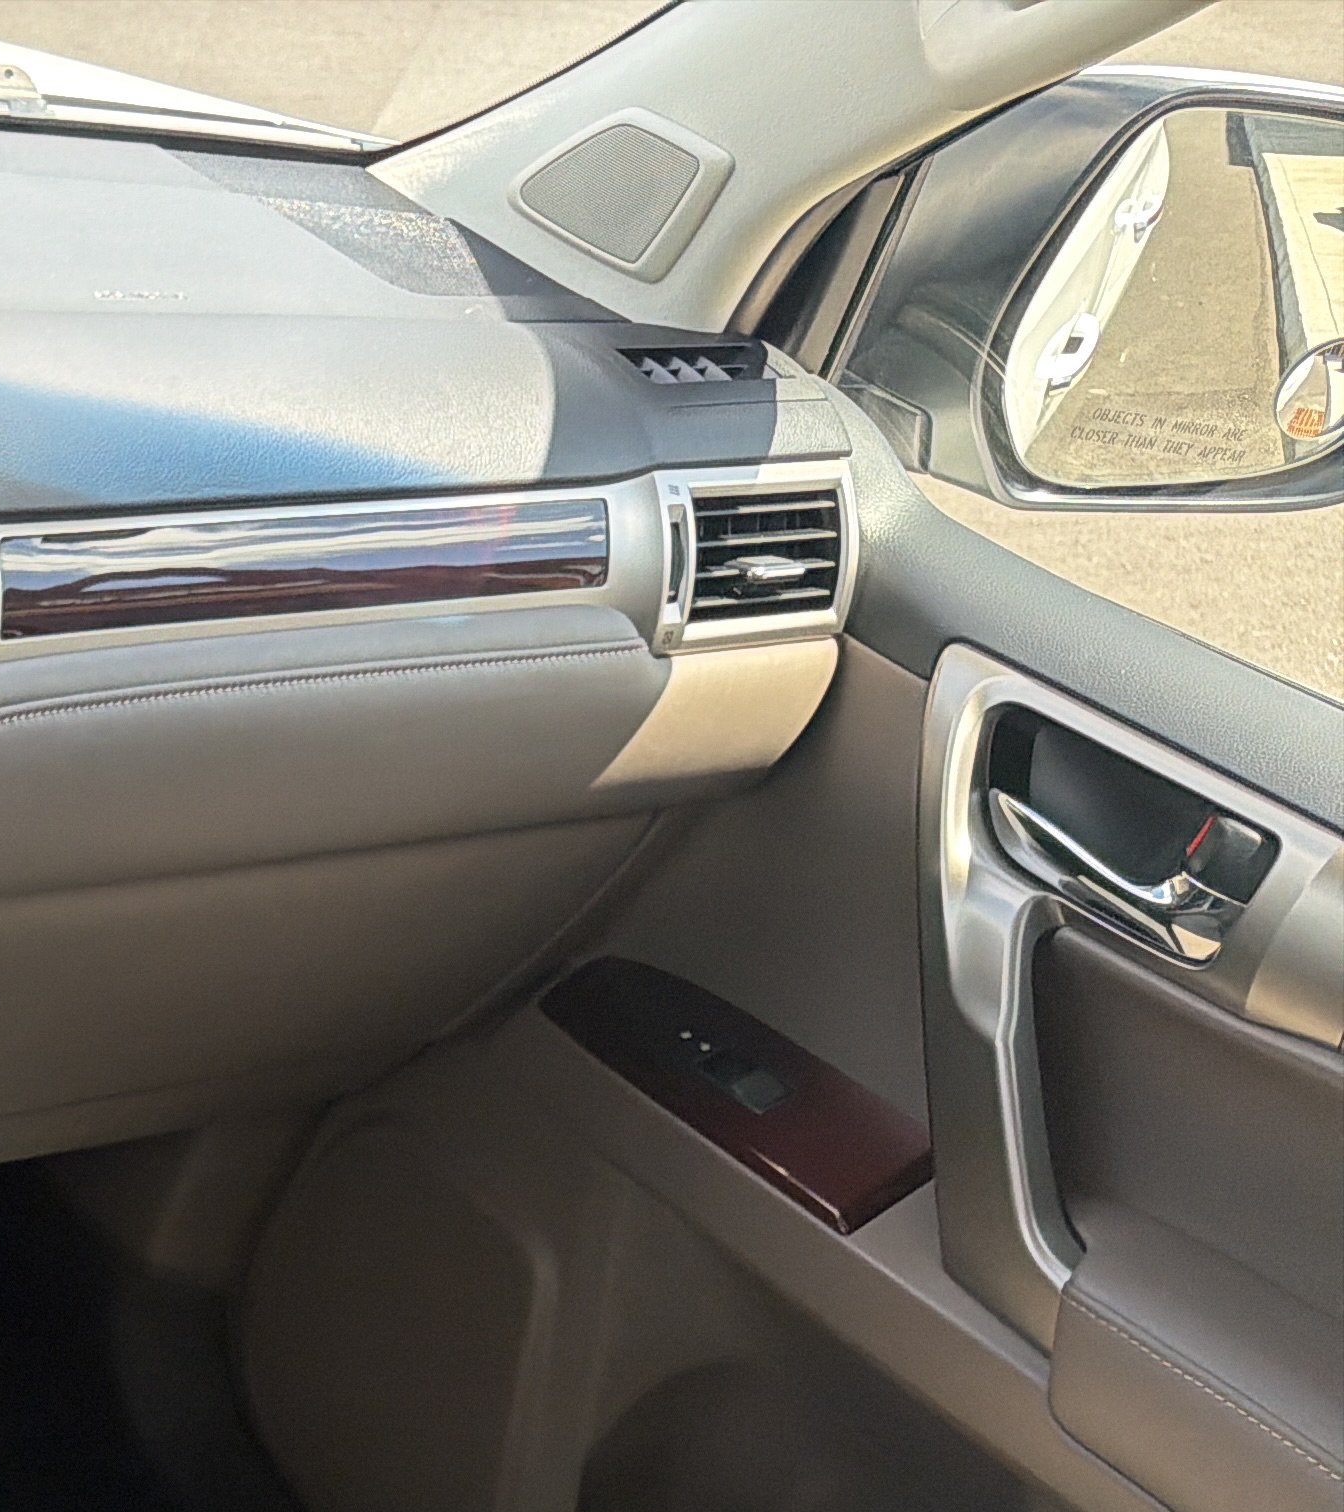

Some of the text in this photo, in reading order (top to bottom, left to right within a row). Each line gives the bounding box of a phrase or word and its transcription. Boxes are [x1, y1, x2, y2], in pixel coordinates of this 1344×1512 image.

[1092, 407, 1248, 442] OBJECTS IN MIRROR ARE
[1070, 425, 1247, 463] CLOSER THAN THEY APPEAR
